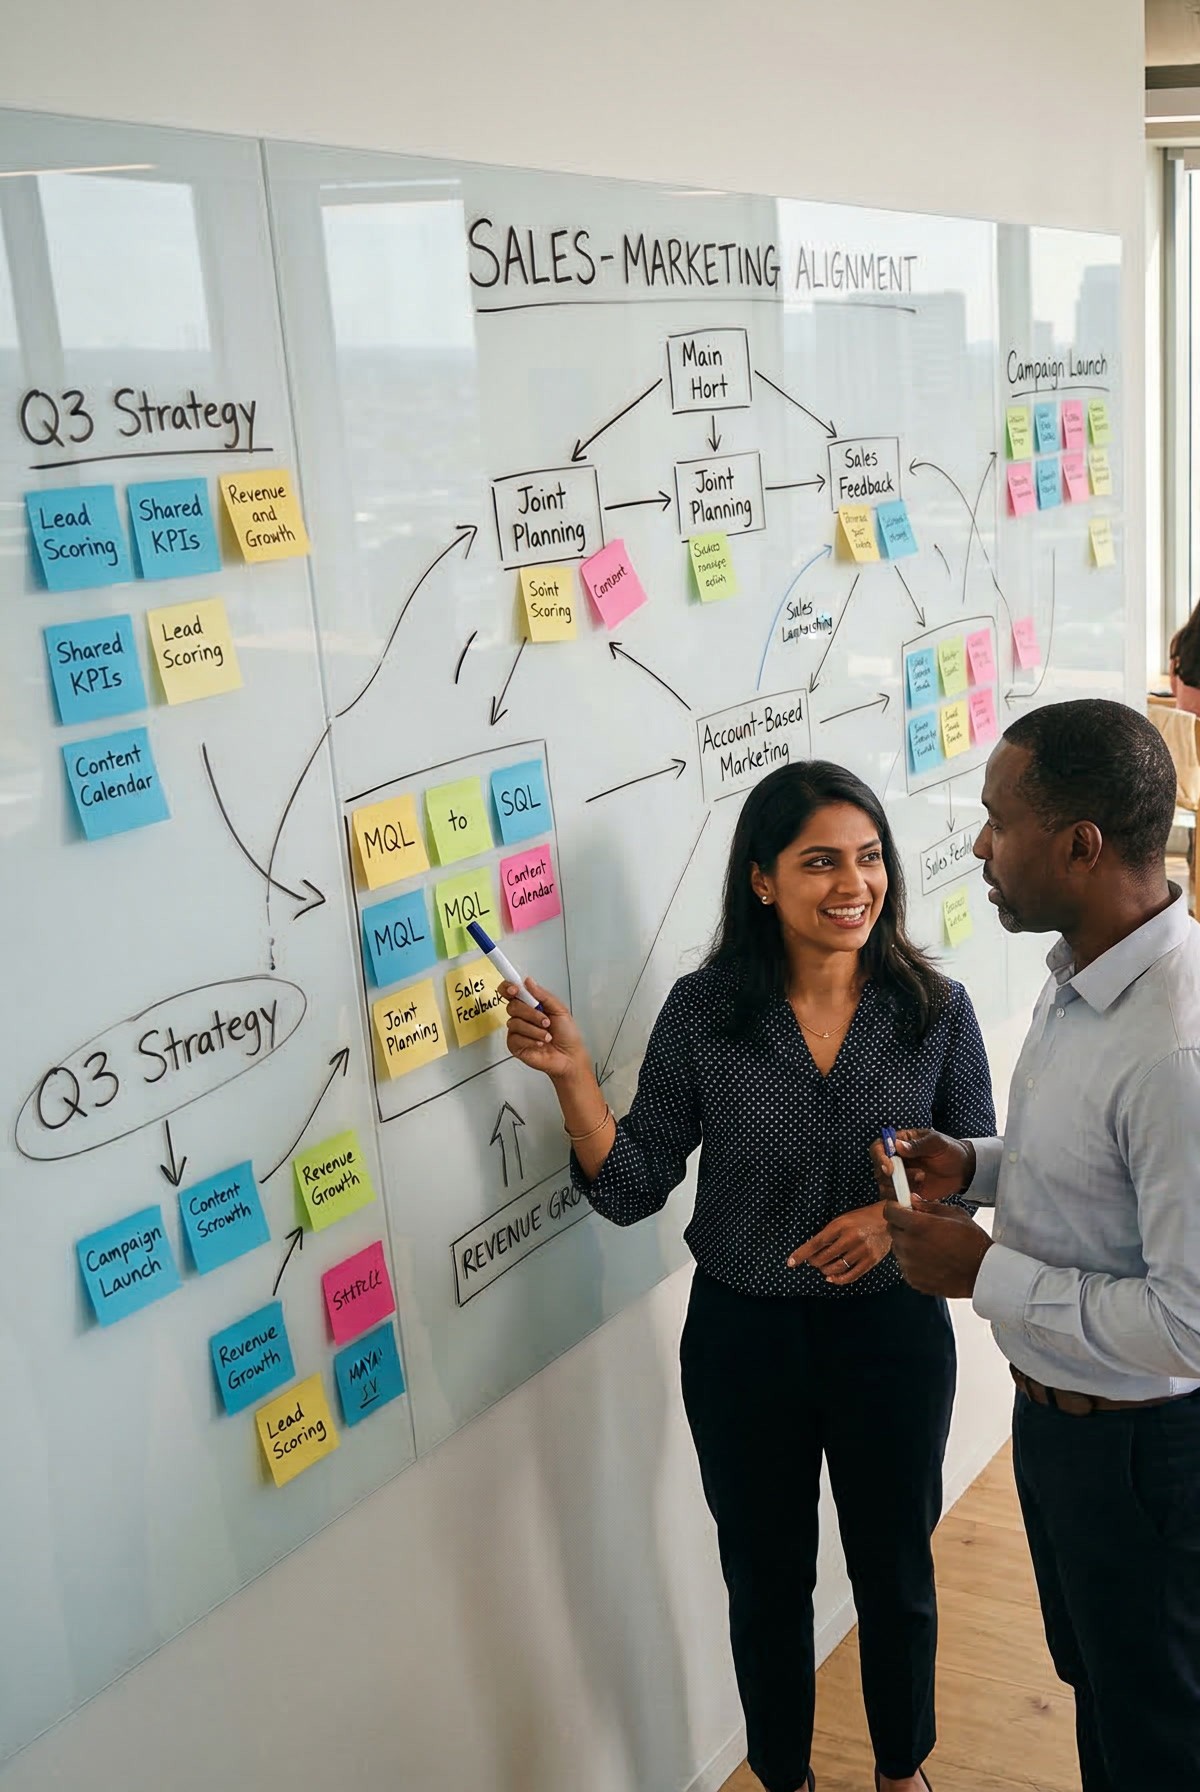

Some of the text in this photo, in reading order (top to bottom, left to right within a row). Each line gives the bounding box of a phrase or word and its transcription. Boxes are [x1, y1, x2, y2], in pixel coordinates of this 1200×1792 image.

[795, 246, 917, 293] ALIGNMENT
[682, 341, 722, 368] Main
[691, 375, 728, 399] Hort
[1006, 350, 1108, 393] Campaign Launch
[20, 388, 256, 452] Q3 Strategy
[844, 448, 878, 468] Sales
[228, 484, 287, 504] Revenue
[695, 467, 734, 493] Joint
[838, 474, 894, 500] Feedback
[139, 493, 203, 522] Shared
[252, 505, 277, 522] and
[517, 484, 566, 514] Joint
[691, 495, 753, 527] Planning
[39, 503, 91, 530] Lead
[43, 537, 118, 566] Scoring
[151, 528, 201, 553] KPIs
[245, 527, 296, 548] Growth
[513, 520, 586, 557] Planning
[162, 615, 203, 641] Lead
[530, 601, 572, 623] Scoring
[57, 633, 123, 663] Shared
[162, 643, 224, 669] Scoring
[70, 667, 122, 696] KPIs
[702, 698, 803, 754] Account-Based
[76, 745, 141, 777] Content
[719, 741, 790, 782] Marketing
[80, 772, 153, 806] Calendar
[501, 785, 541, 817] SQL
[448, 809, 467, 831] to
[364, 821, 415, 858] MQL
[444, 891, 490, 929] MQL
[511, 883, 554, 910] Calendar
[374, 921, 425, 957] MQL
[455, 978, 485, 1001] Sales
[383, 1002, 418, 1032] Joint
[387, 1021, 439, 1055] Planning
[36, 999, 277, 1129] Q3 Strategy
[302, 1150, 356, 1185] Revenue
[189, 1183, 240, 1215] Content
[311, 1171, 360, 1206] Growth
[86, 1226, 163, 1272] Campaign
[462, 1204, 541, 1280] REVENUE
[99, 1257, 162, 1298] Launch
[218, 1325, 278, 1367] Revenue
[227, 1351, 281, 1390] Growth
[266, 1403, 305, 1438] Lead
[272, 1419, 327, 1460] Scoring
